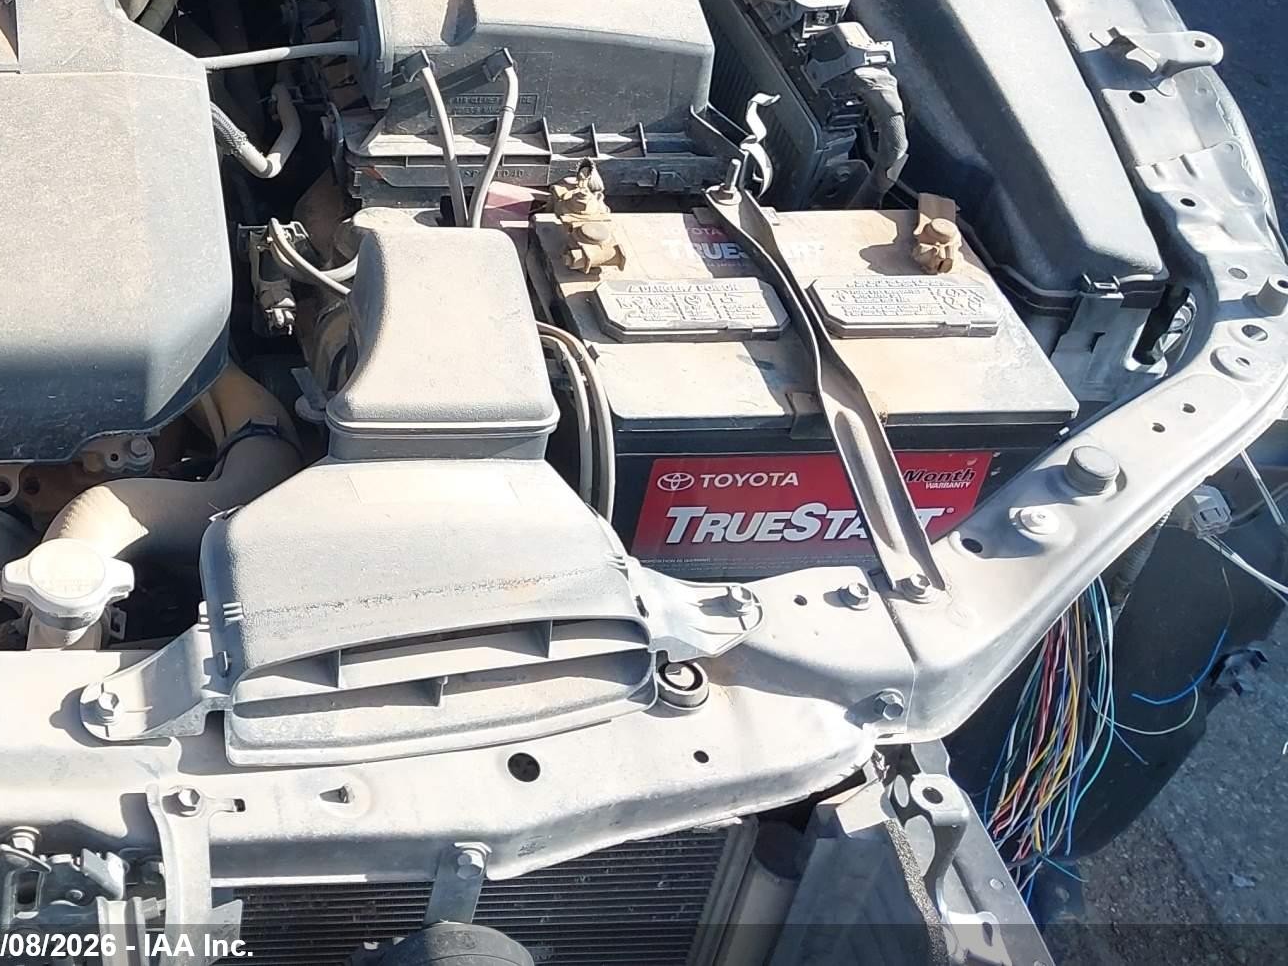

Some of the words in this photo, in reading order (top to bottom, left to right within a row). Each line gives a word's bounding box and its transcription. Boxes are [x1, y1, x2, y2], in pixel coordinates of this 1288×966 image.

[699, 472, 799, 488] TOYOTA
[904, 468, 976, 483] Month
[925, 481, 971, 490] WARRANTY
[665, 502, 945, 544] TRUESTAT
